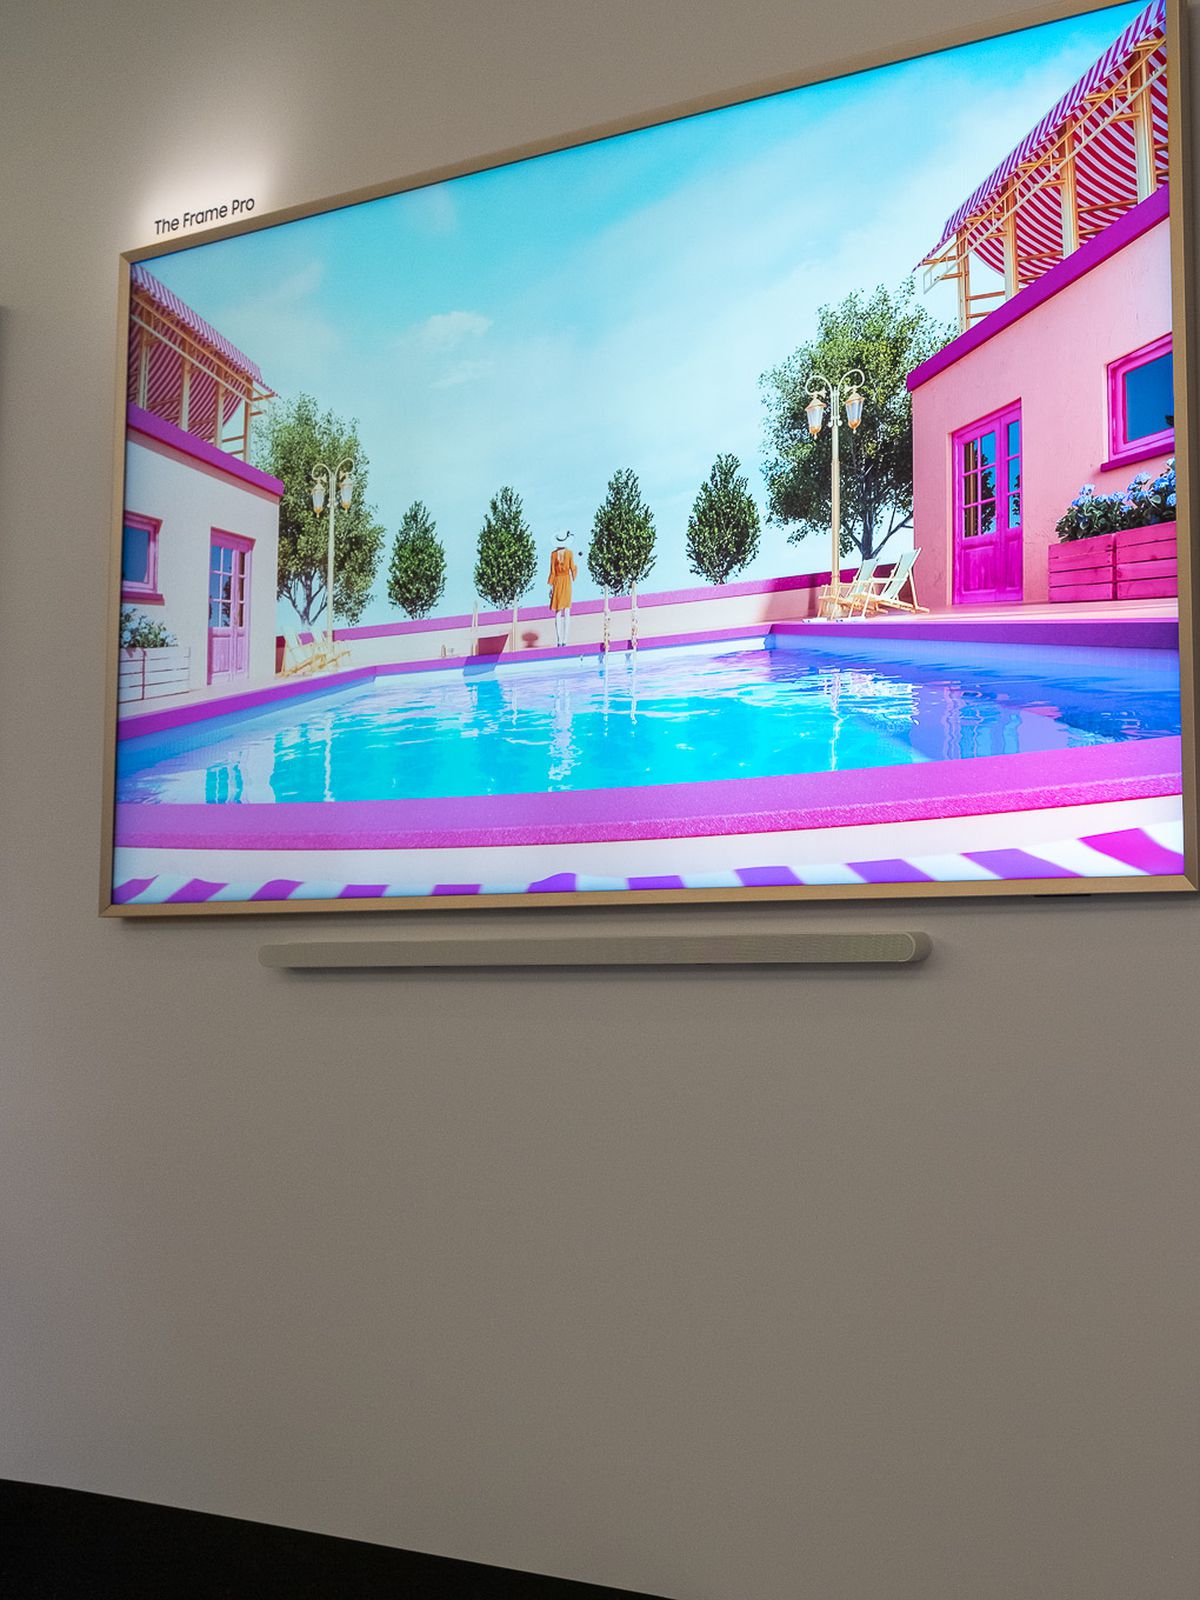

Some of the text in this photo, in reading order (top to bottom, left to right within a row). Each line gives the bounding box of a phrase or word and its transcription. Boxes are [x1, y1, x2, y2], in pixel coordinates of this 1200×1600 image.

[154, 198, 255, 236] The Frame Pro
